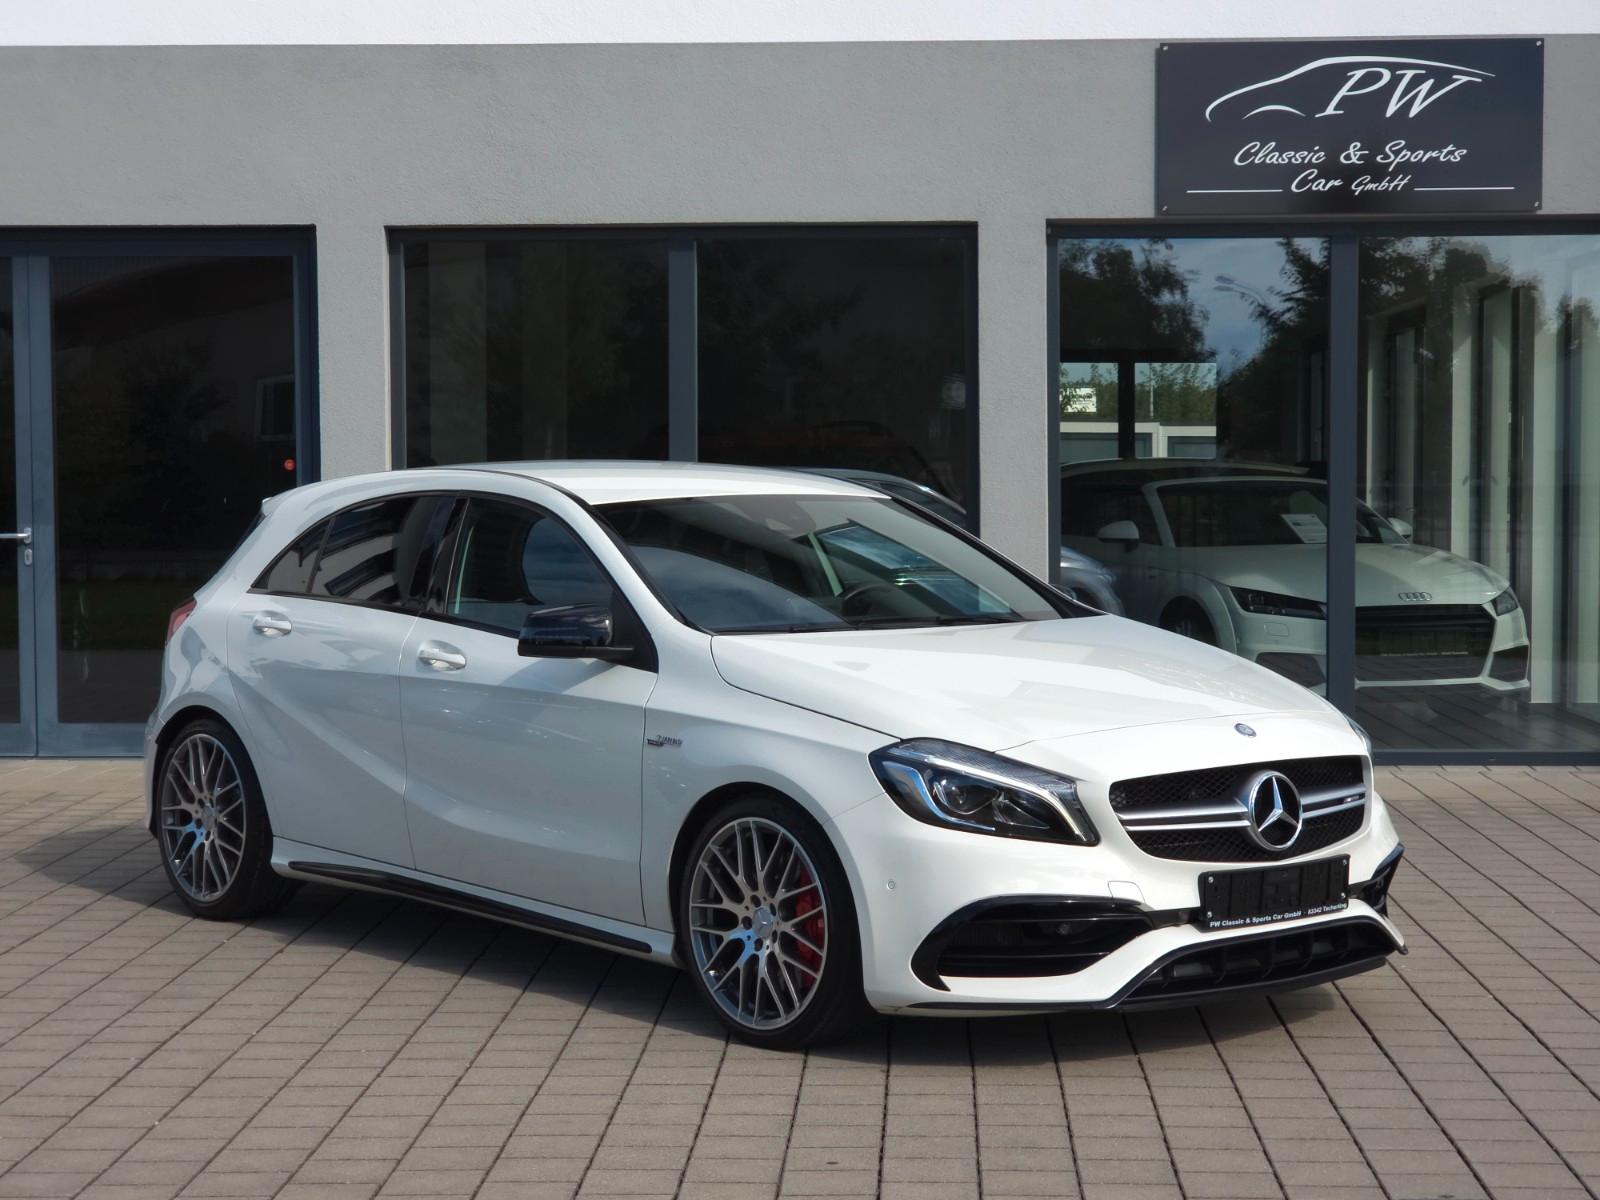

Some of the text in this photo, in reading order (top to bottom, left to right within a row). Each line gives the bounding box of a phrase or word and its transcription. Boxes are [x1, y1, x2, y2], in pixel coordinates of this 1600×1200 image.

[1314, 67, 1483, 118] PW
[1233, 139, 1468, 172] Classic & Sports
[1291, 168, 1412, 196] Car GmbH
[1209, 920, 1221, 928] PW
[1221, 919, 1244, 927] Classic
[1252, 915, 1272, 923] Sports
[1284, 910, 1302, 919] GmbH
